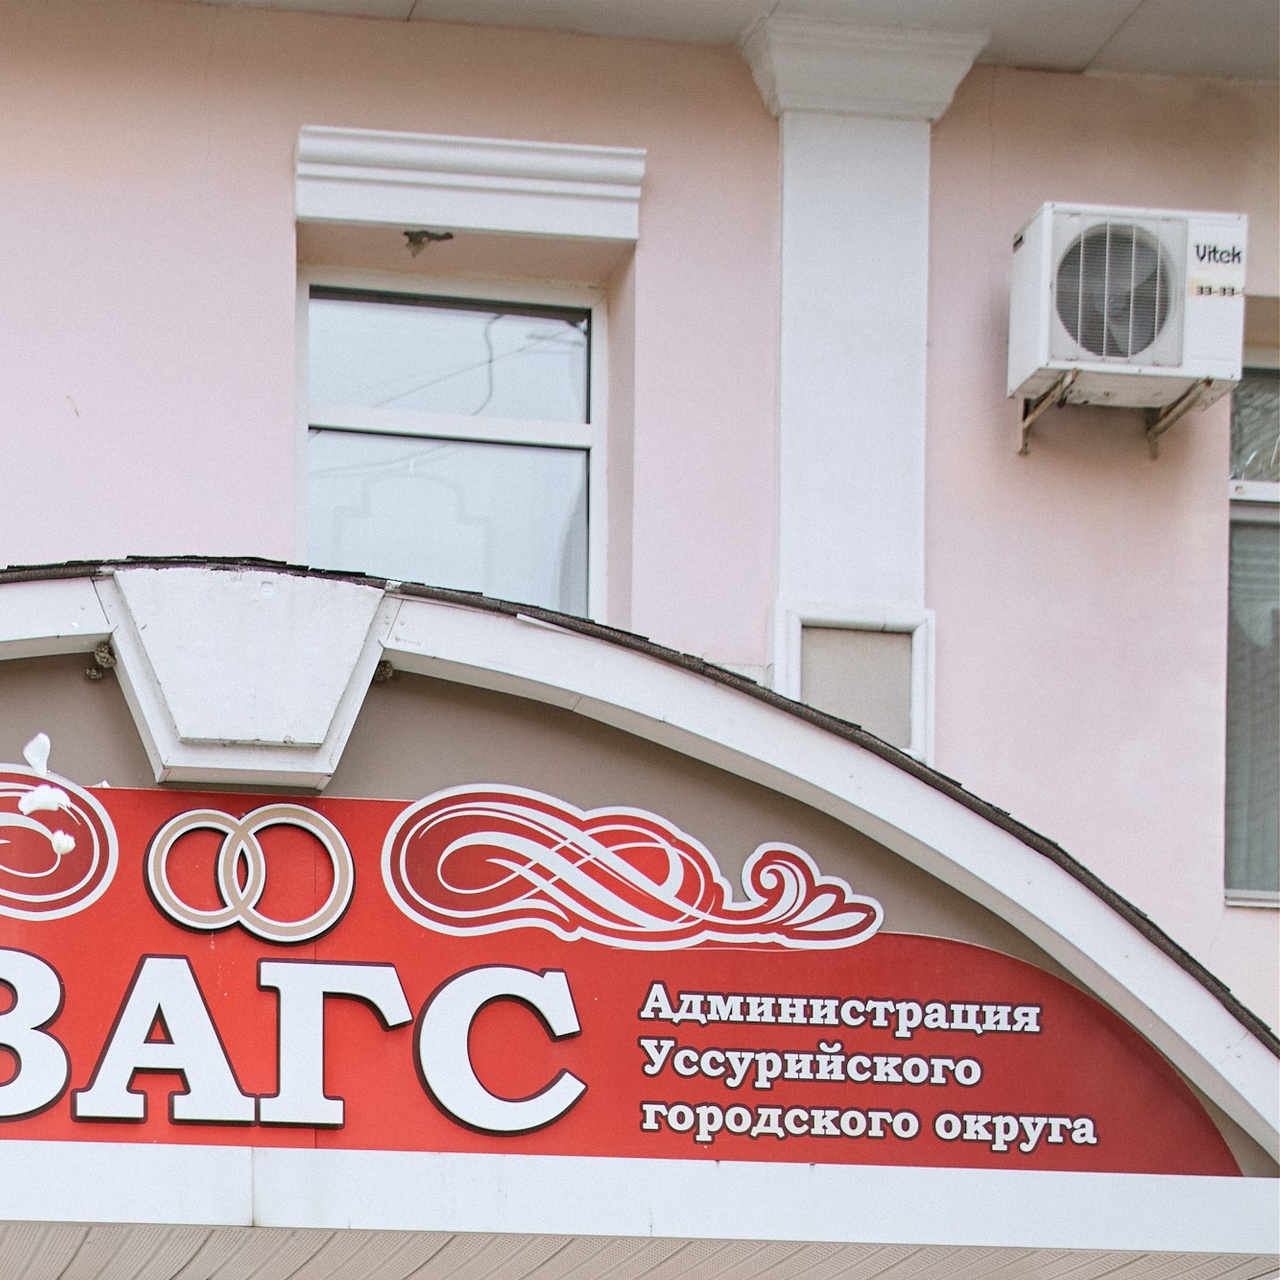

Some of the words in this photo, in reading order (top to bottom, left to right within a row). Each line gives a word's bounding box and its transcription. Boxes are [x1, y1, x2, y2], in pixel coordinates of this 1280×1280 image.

[1195, 244, 1242, 264] Vitek
[639, 982, 1041, 1038] Администрация
[639, 1038, 983, 1088] Уссурийского
[641, 1103, 920, 1142] городского
[934, 1112, 1098, 1152] округа
